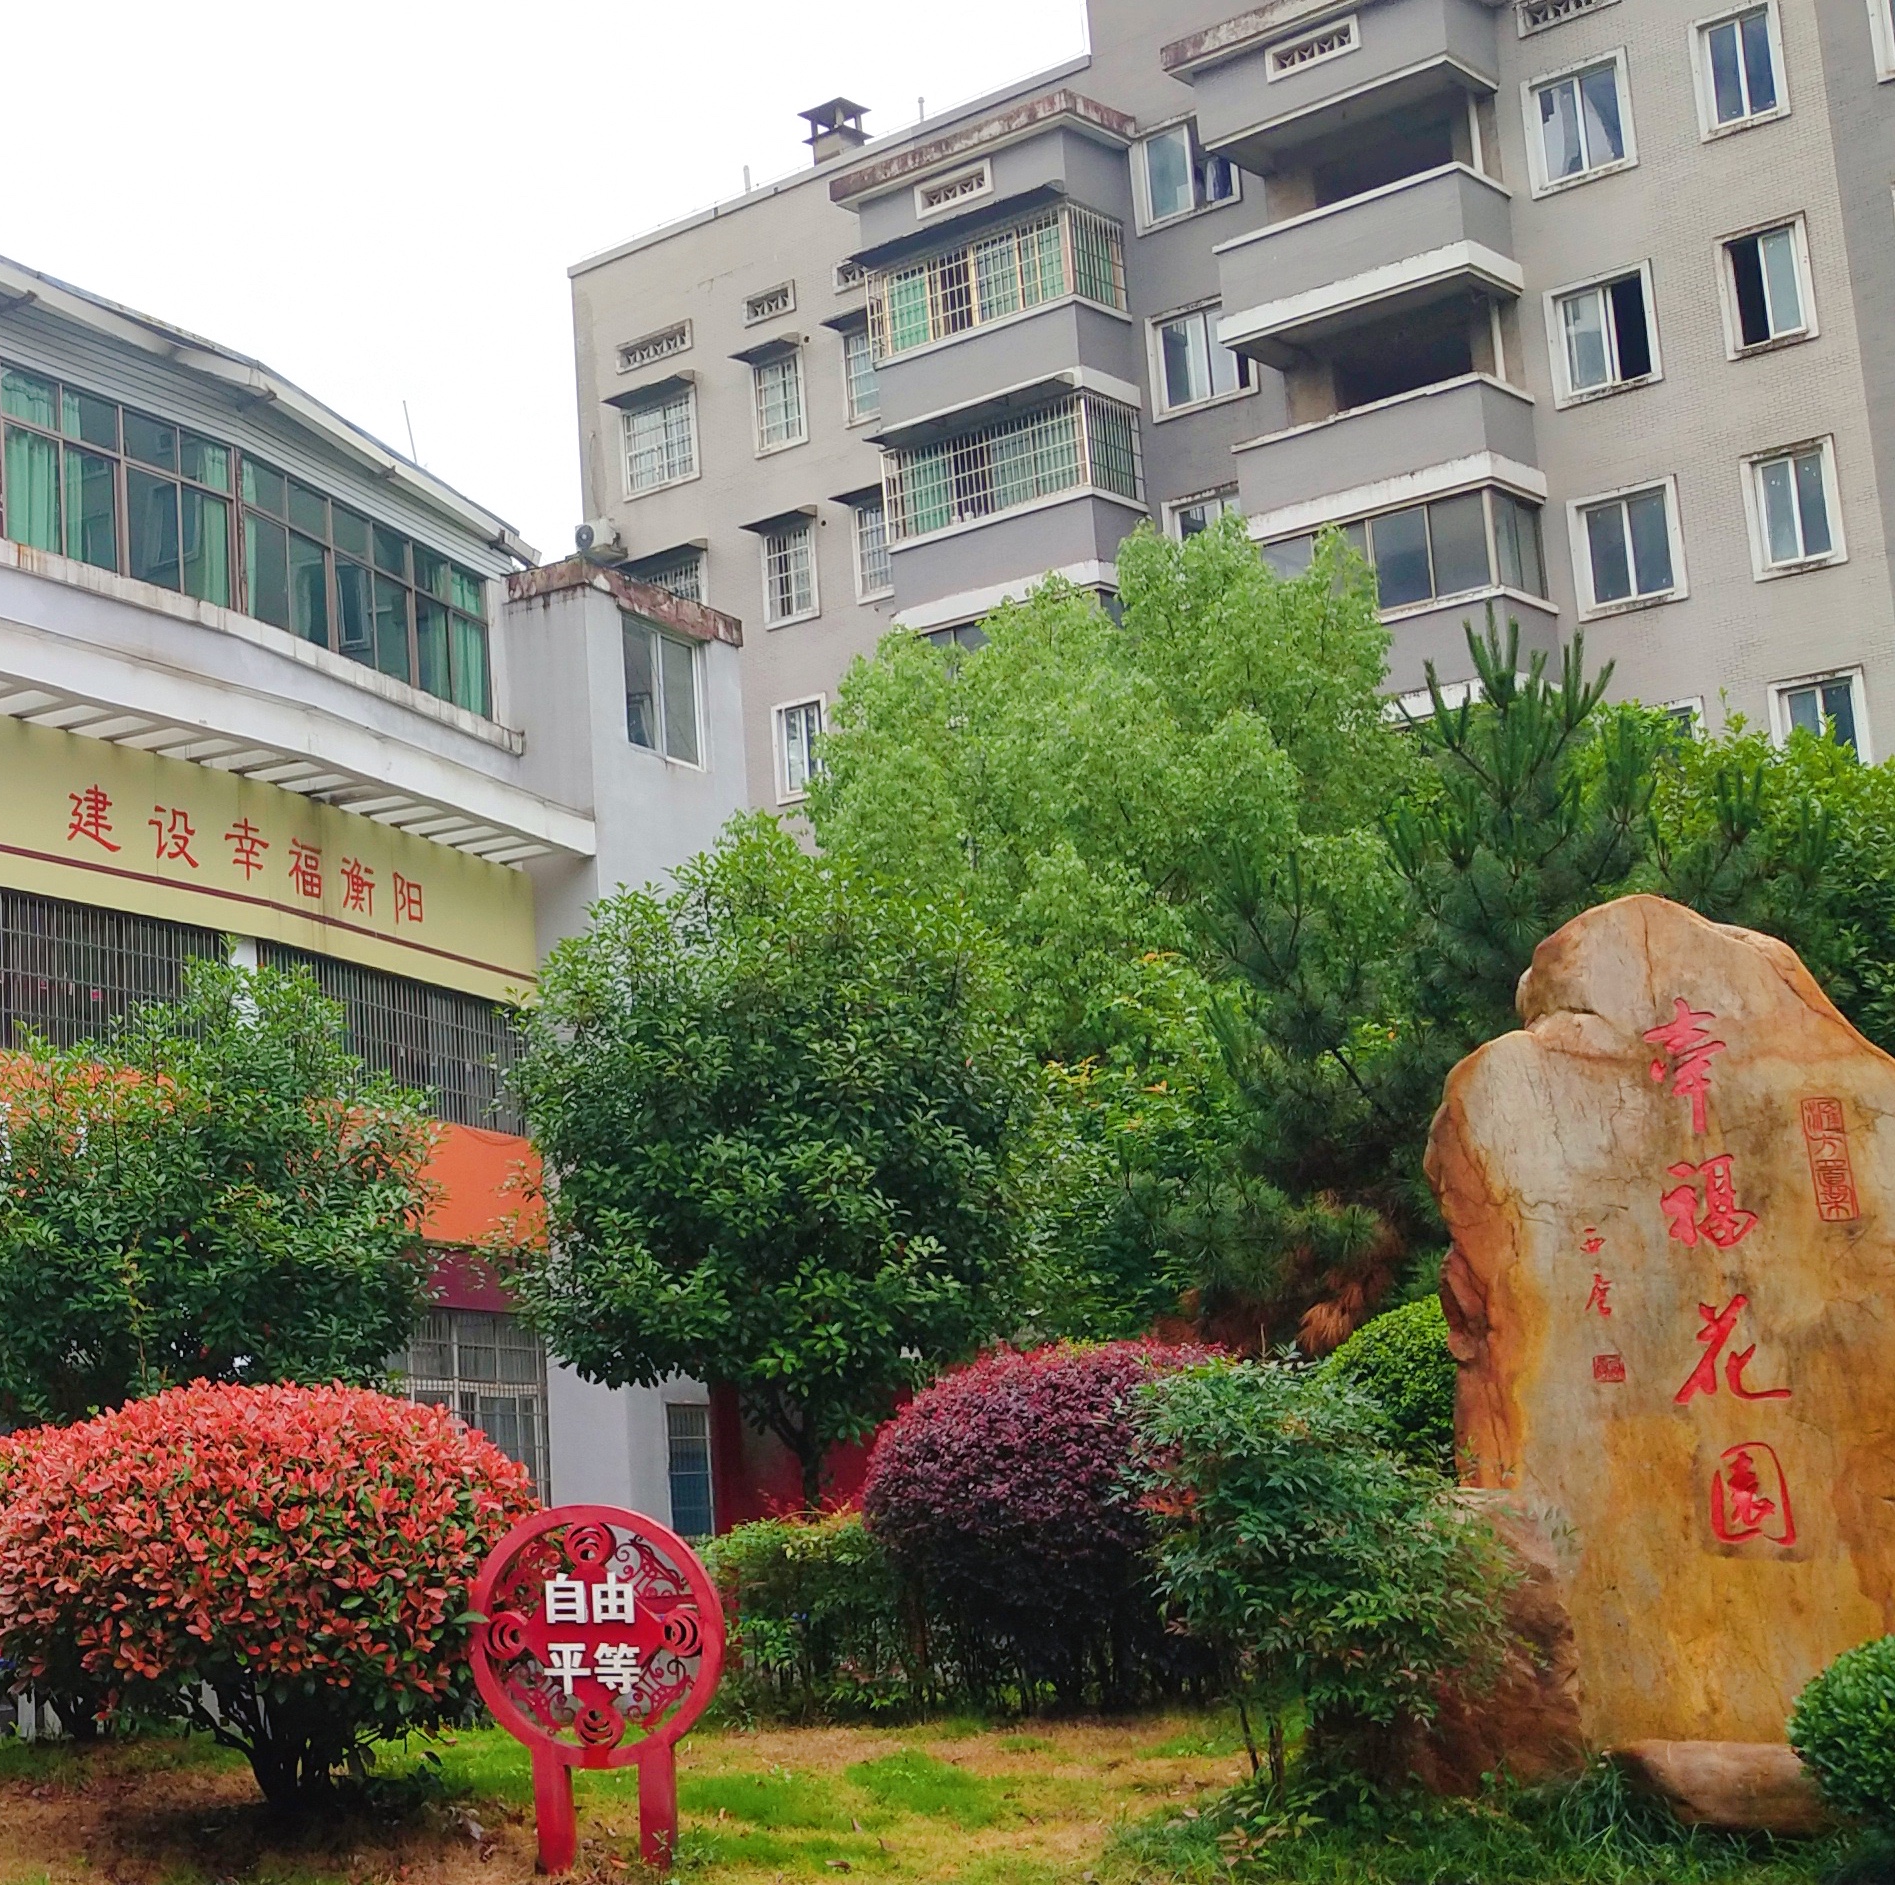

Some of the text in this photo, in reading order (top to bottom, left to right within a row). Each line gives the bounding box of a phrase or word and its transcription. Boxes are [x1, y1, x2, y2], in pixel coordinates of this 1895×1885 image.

[67, 783, 424, 924] 建设幸福衡阳
[544, 1572, 635, 1624] 自由
[544, 1643, 642, 1694] 平等
